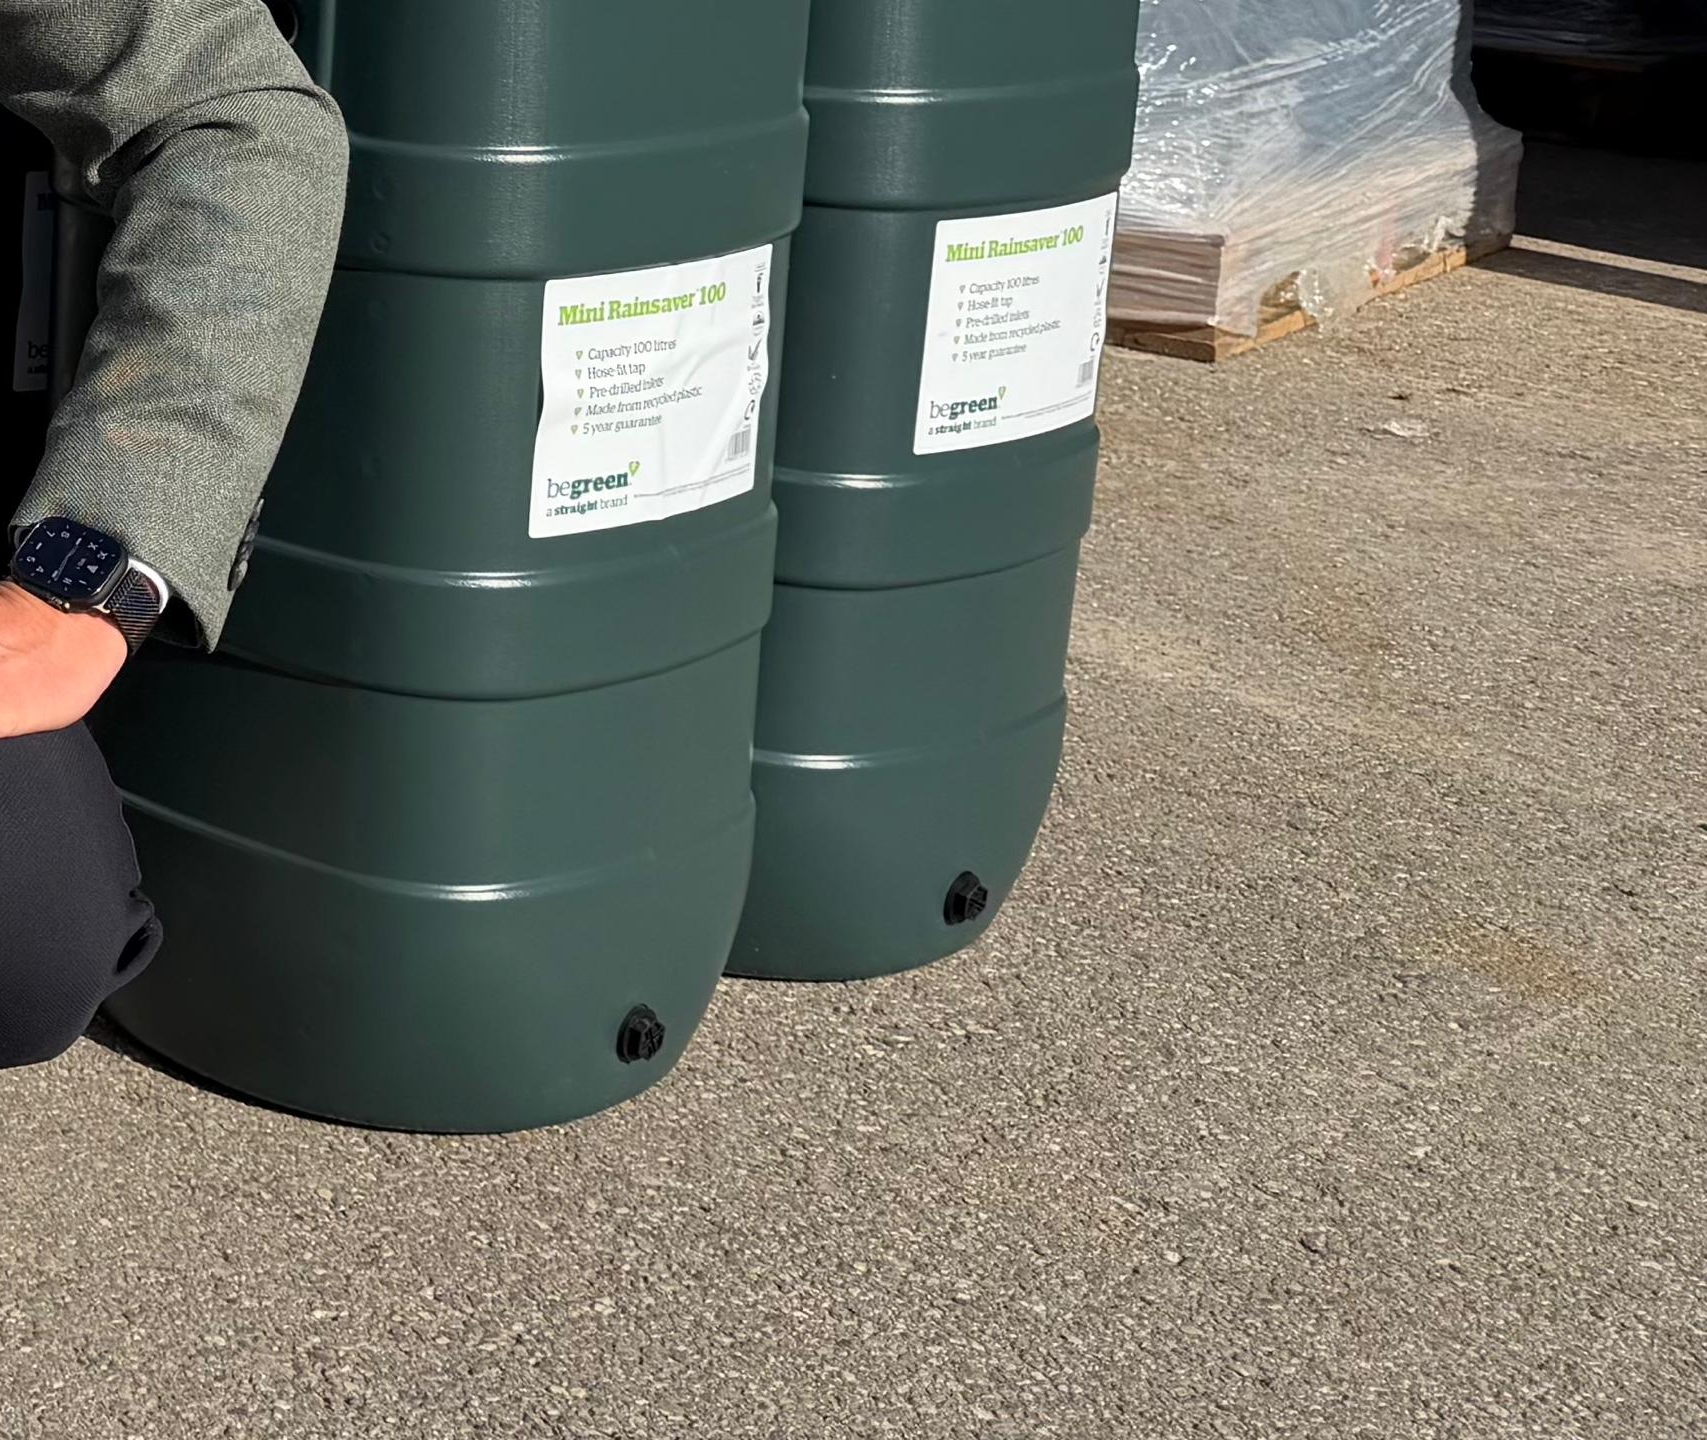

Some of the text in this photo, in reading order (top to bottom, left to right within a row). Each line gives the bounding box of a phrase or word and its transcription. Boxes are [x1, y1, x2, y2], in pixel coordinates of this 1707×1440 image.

[945, 225, 1084, 262] Mini Rainsaver 100
[557, 301, 605, 326] Mini
[607, 291, 696, 321] Rainsaver
[698, 281, 727, 306] 100
[588, 339, 677, 361] Capacity 100 litres
[629, 363, 646, 376] tap
[586, 402, 616, 417] Made
[617, 400, 642, 413] from
[643, 390, 677, 409] recycled
[930, 396, 998, 420] begreen
[582, 415, 662, 436] 5 year guarantee
[935, 421, 972, 434] straight
[547, 471, 629, 500] begreen
[546, 494, 628, 517] a straight brand
